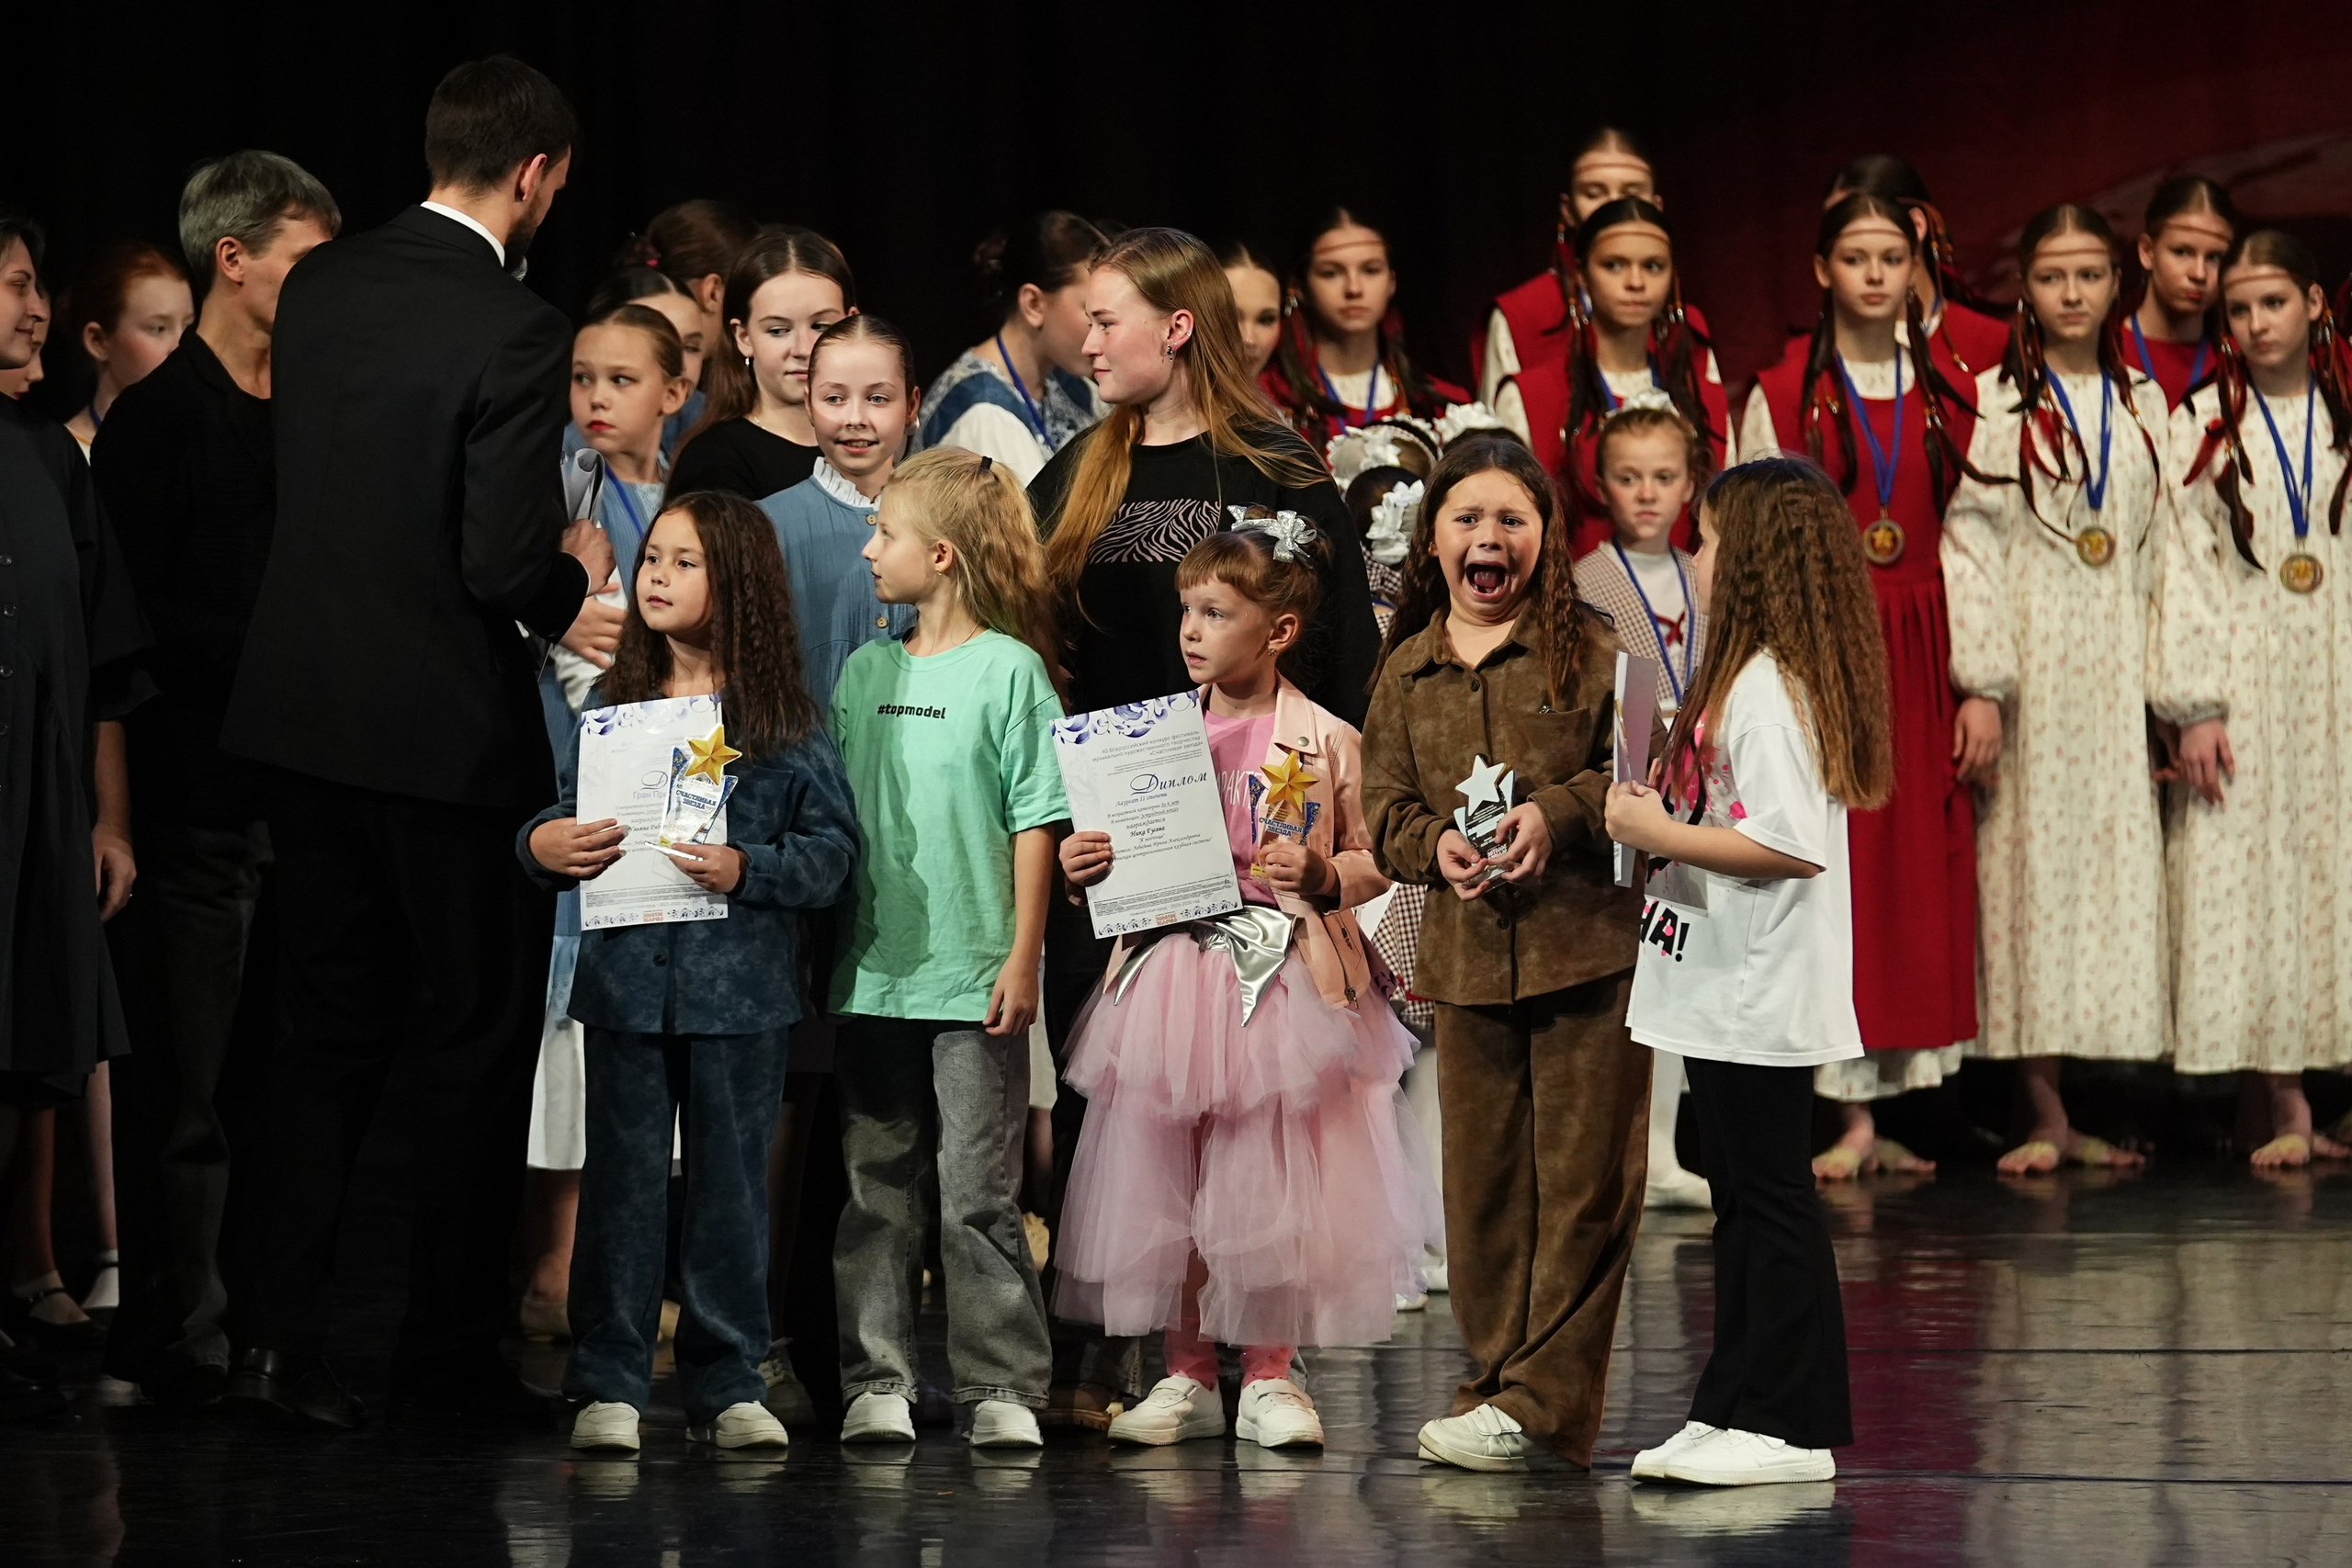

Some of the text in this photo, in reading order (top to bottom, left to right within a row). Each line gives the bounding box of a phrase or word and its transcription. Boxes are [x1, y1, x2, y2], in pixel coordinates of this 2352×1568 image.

[876, 704, 946, 719] #topmodel
[1109, 739, 1148, 753] Всероссийский
[1149, 731, 1200, 744] конкурс-фестиваль
[1170, 736, 1201, 746] творчества
[1129, 772, 1207, 796] Диплом
[633, 791, 651, 799] Гран
[675, 789, 718, 807] СЧАСТЛИВАЯ
[682, 797, 706, 810] ЗВЕЗДА
[1126, 817, 1166, 829] награждается
[1259, 817, 1303, 833] СЧАСТЛИВАЯ
[1147, 826, 1165, 835] Гусева
[1267, 825, 1292, 837] ЗВЕЗДА
